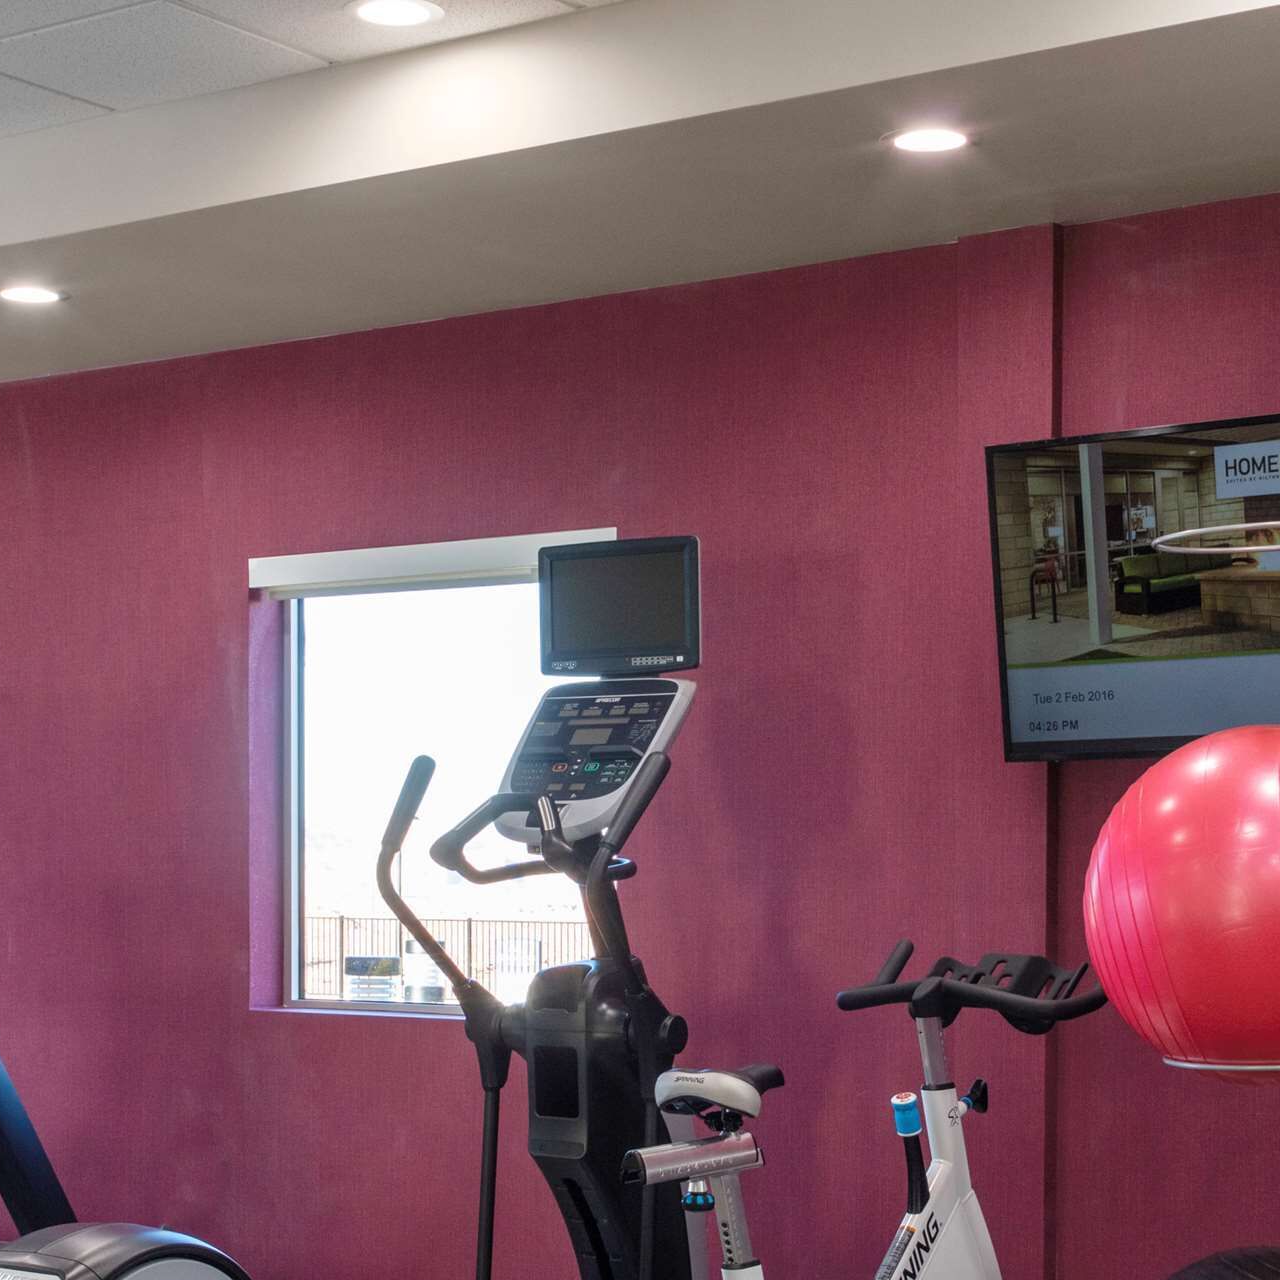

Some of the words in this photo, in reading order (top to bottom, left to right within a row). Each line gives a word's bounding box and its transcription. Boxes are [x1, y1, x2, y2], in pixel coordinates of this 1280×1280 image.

[1032, 693, 1053, 704] Tue
[1054, 692, 1062, 703] 2
[1064, 691, 1085, 702] Feb
[1087, 689, 1115, 702] 2016
[1061, 720, 1080, 731] PM
